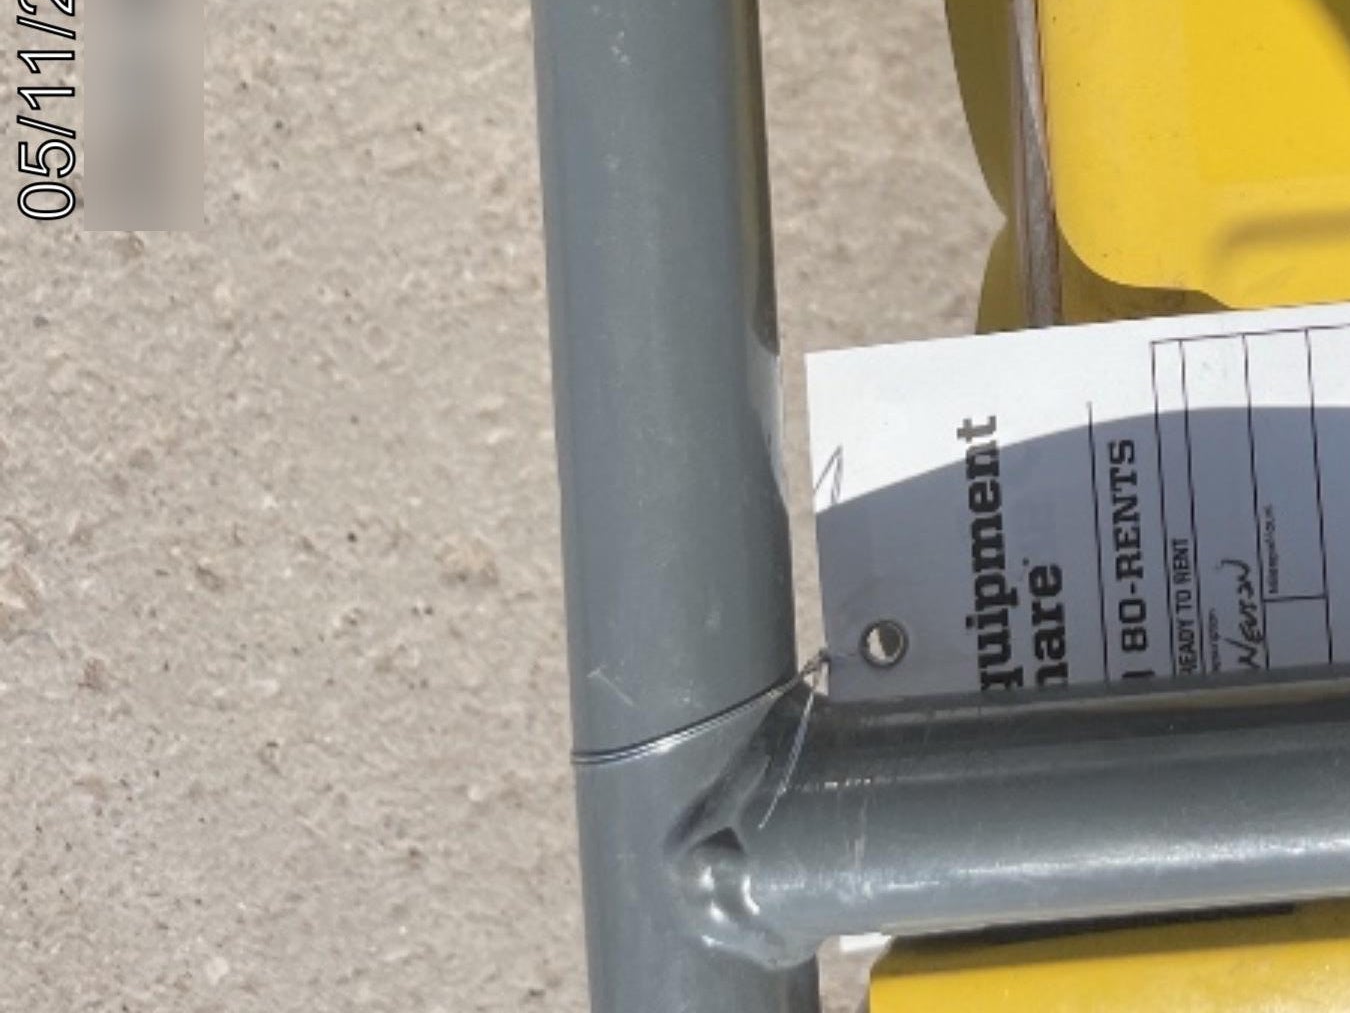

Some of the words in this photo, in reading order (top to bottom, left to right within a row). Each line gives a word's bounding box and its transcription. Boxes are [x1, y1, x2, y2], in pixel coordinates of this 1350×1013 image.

[957, 415, 1024, 692] quipment
[1107, 438, 1148, 653] 80-RENTS
[1171, 537, 1193, 585] RENT
[1174, 589, 1193, 615] TO
